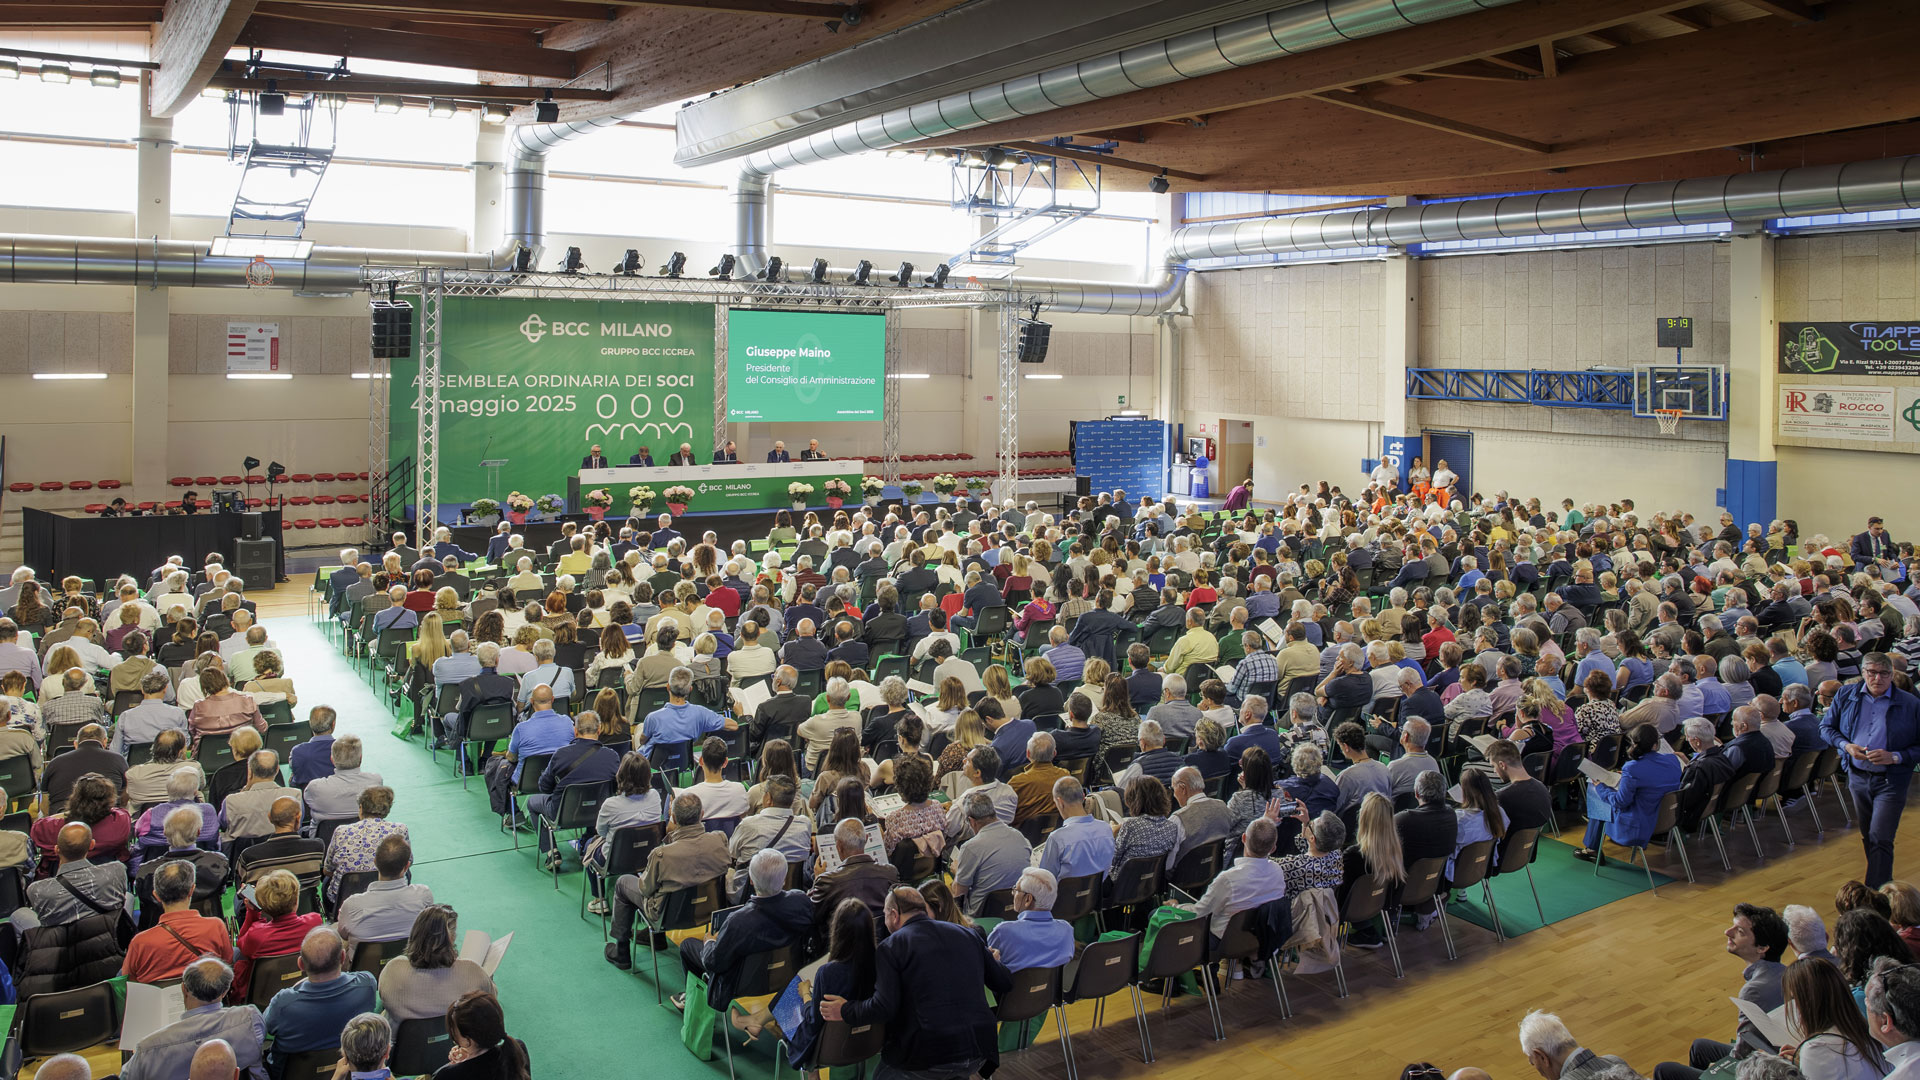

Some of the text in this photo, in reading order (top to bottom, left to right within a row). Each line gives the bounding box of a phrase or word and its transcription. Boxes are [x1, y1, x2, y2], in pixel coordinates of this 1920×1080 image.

[1667, 318, 1688, 328] 9:19
[552, 322, 672, 337] BCC MILANO
[1860, 339, 1920, 351] TOOLS
[601, 347, 695, 356] GRUPPO BCC ICCREA
[746, 346, 831, 359] Giuseppe Maino
[746, 363, 791, 373] Presidente
[524, 374, 620, 388] ORDINARIA
[625, 374, 651, 388] DEI
[656, 374, 694, 387] SOCI
[745, 375, 876, 386] del Consiglio di Amministrazione
[438, 394, 520, 417] maggio
[525, 394, 577, 412] 2025
[1839, 402, 1884, 412] ROCCO
[725, 483, 752, 491] MILANO
